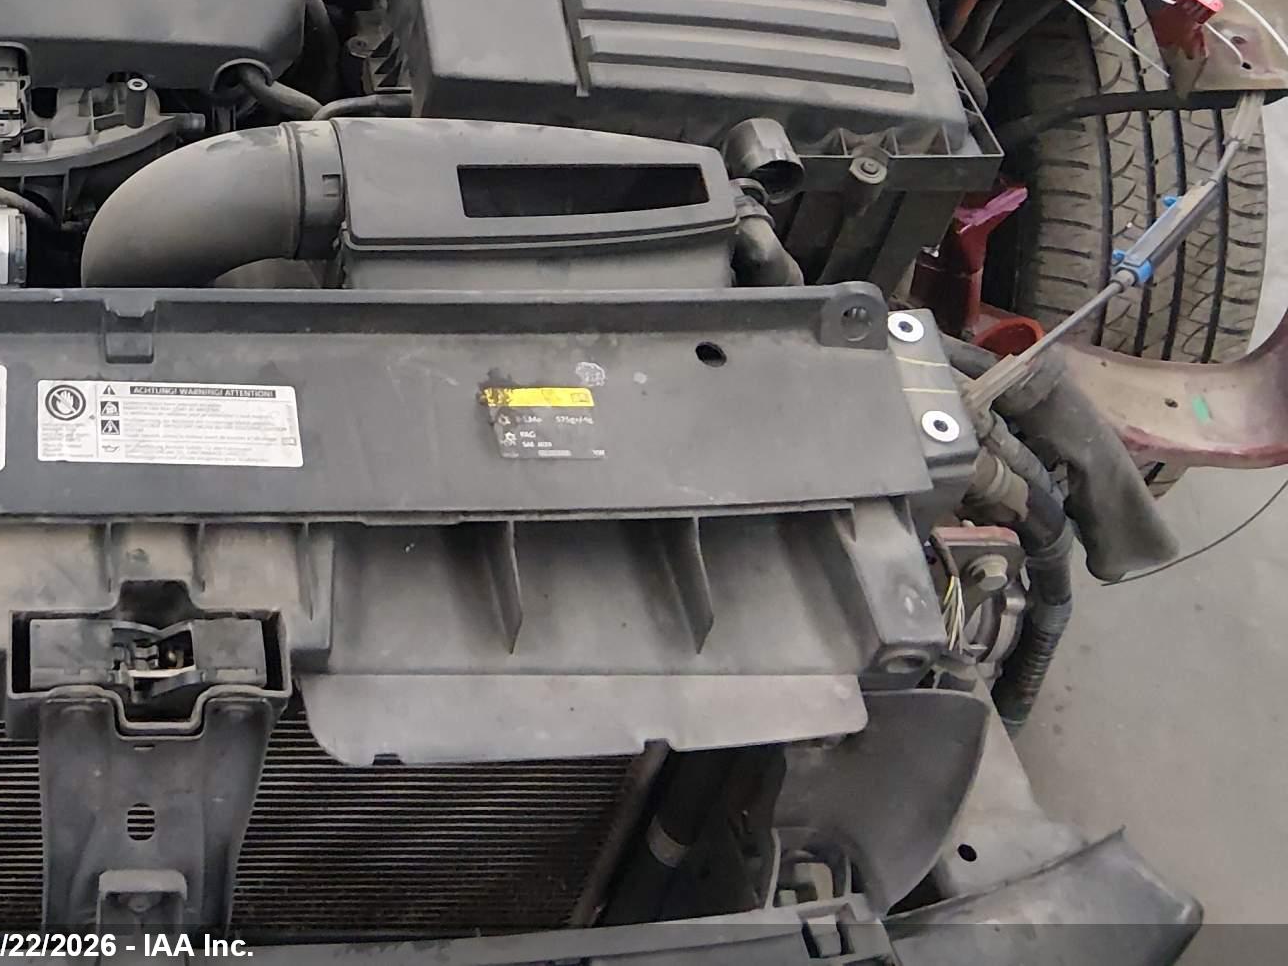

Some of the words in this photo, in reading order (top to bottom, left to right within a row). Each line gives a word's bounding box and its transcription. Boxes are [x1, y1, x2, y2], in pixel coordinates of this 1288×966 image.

[133, 386, 177, 395] ACHTUNG!
[179, 388, 223, 396] WARNING!
[224, 389, 273, 398] ATTENTION!
